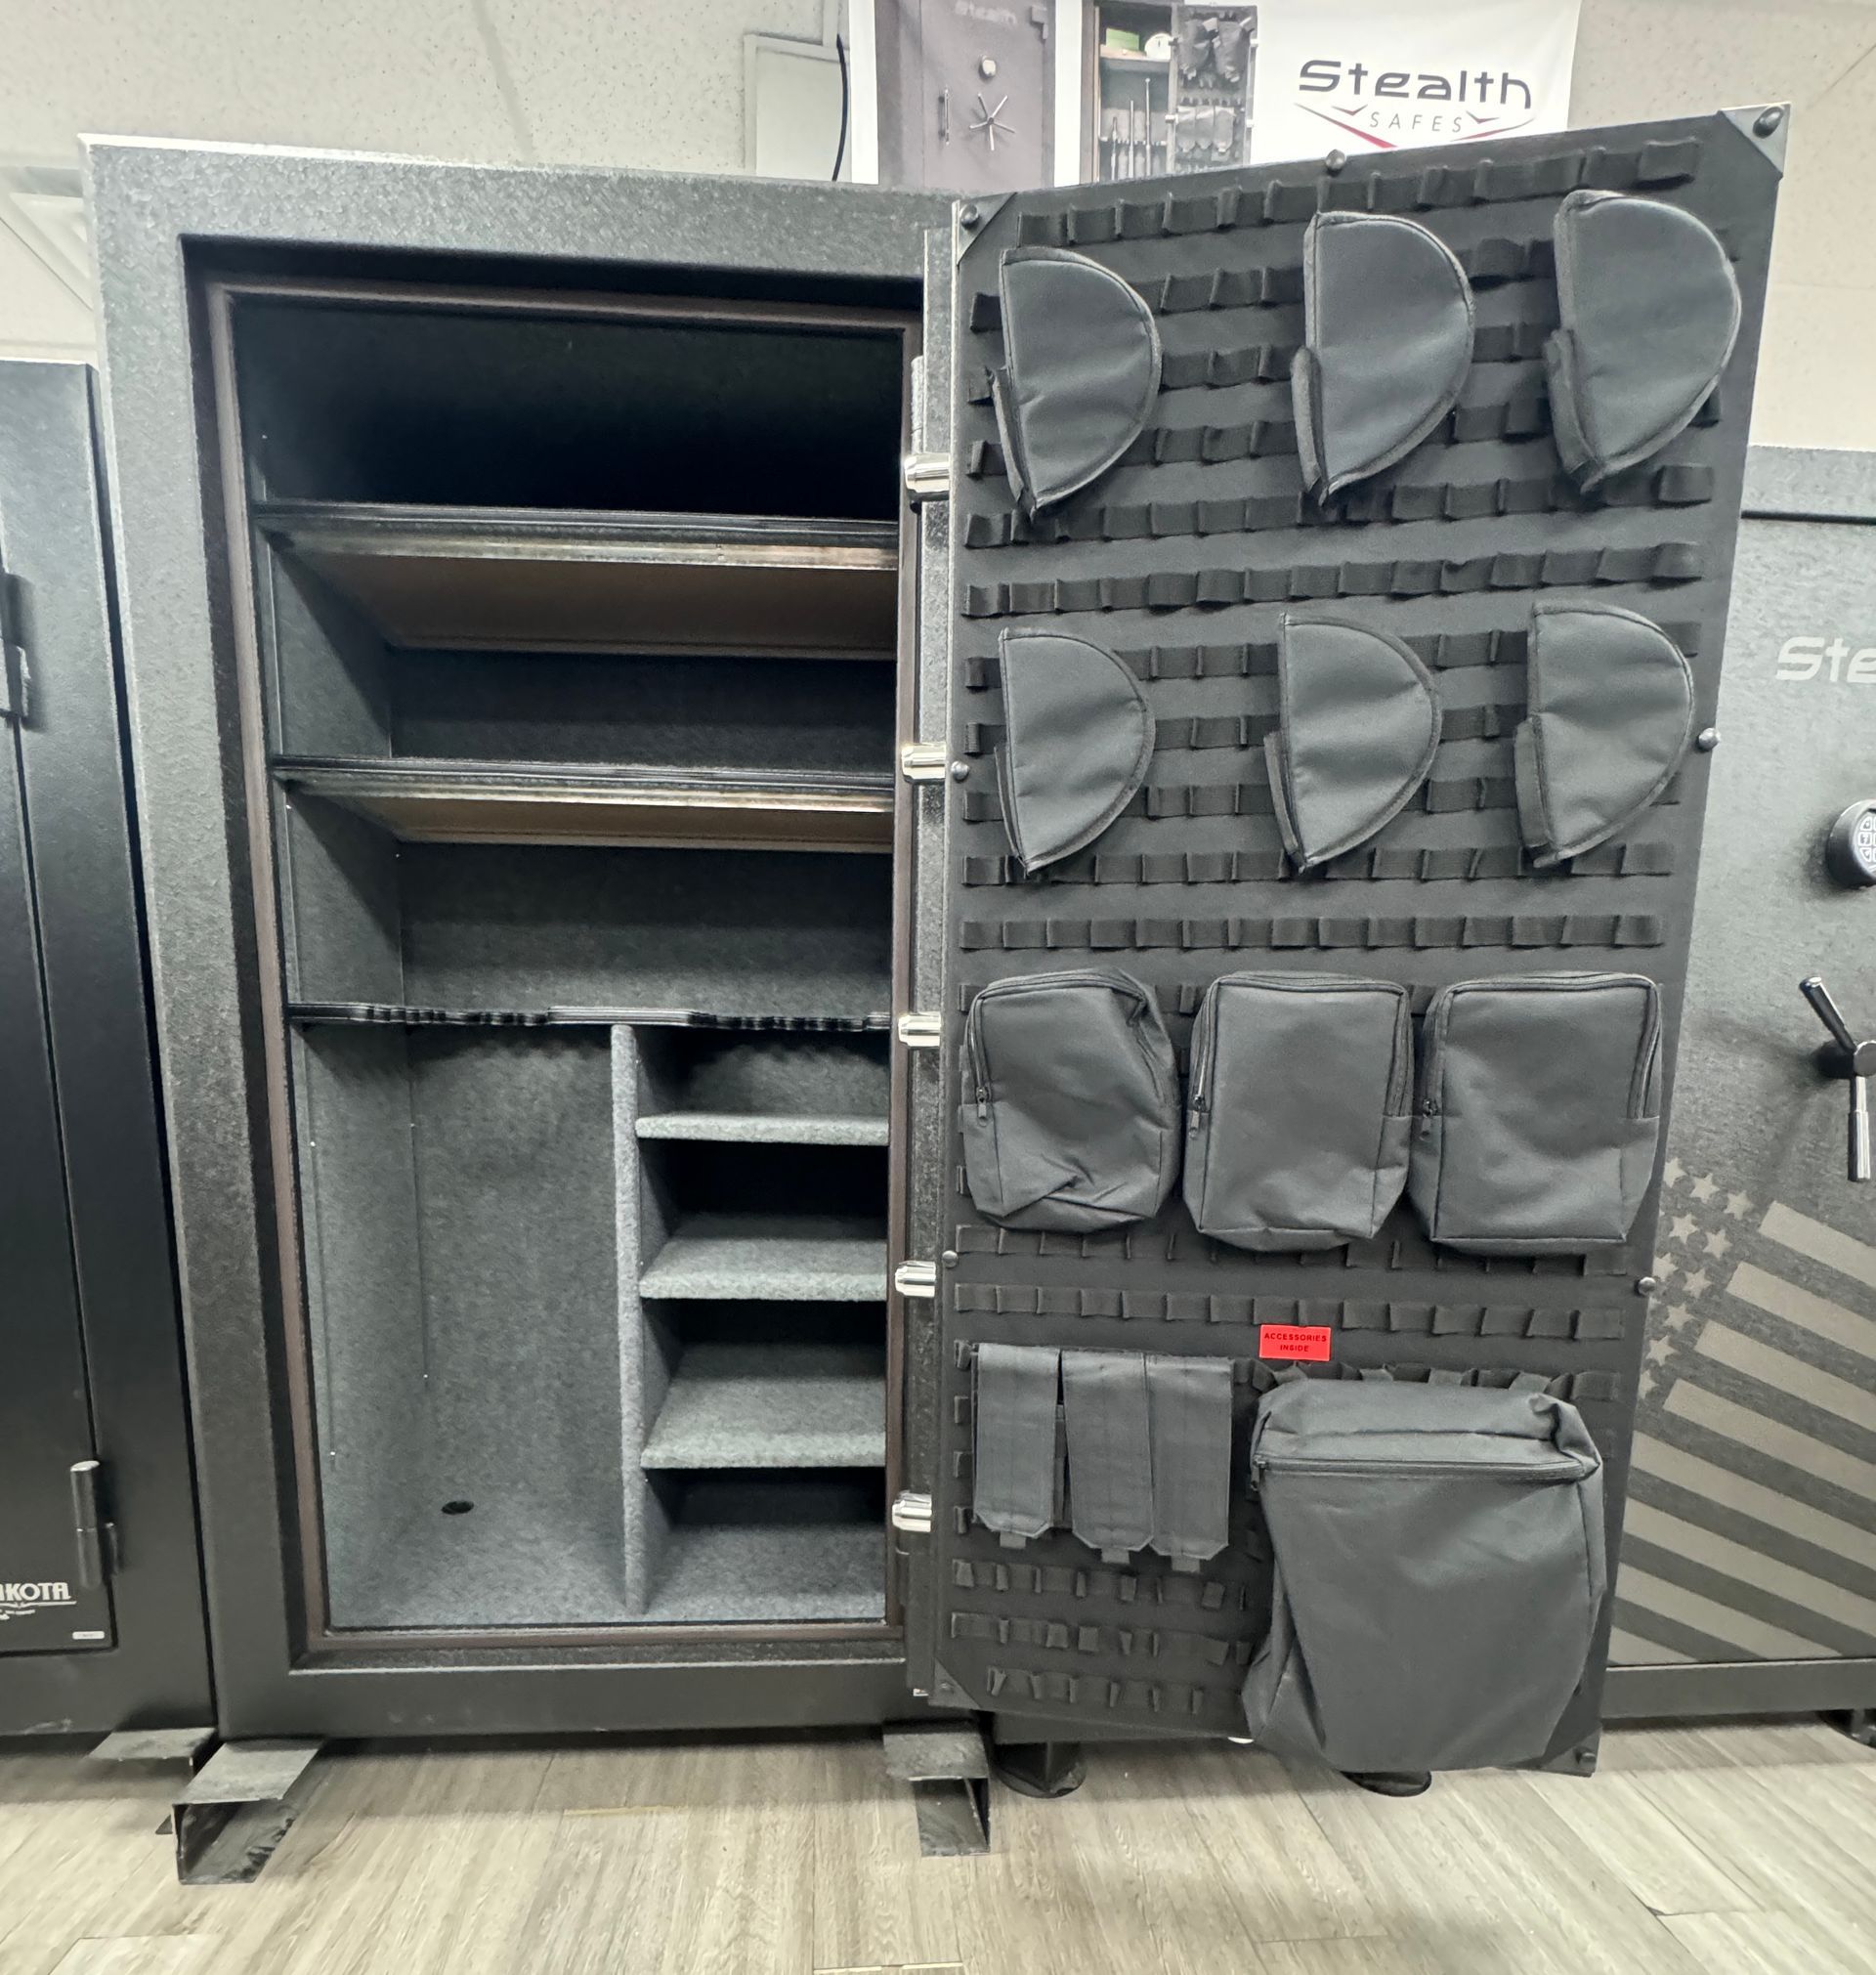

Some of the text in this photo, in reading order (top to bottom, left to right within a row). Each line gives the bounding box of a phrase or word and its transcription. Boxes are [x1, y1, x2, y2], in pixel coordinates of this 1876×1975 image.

[1299, 59, 1531, 109] Stealth
[1369, 110, 1463, 133] SAFES
[1775, 636, 1876, 683] Ste
[1263, 1332, 1327, 1343] ACCESSORIES
[1280, 1344, 1309, 1352] INSIDE
[0, 1582, 71, 1601] KOTA
